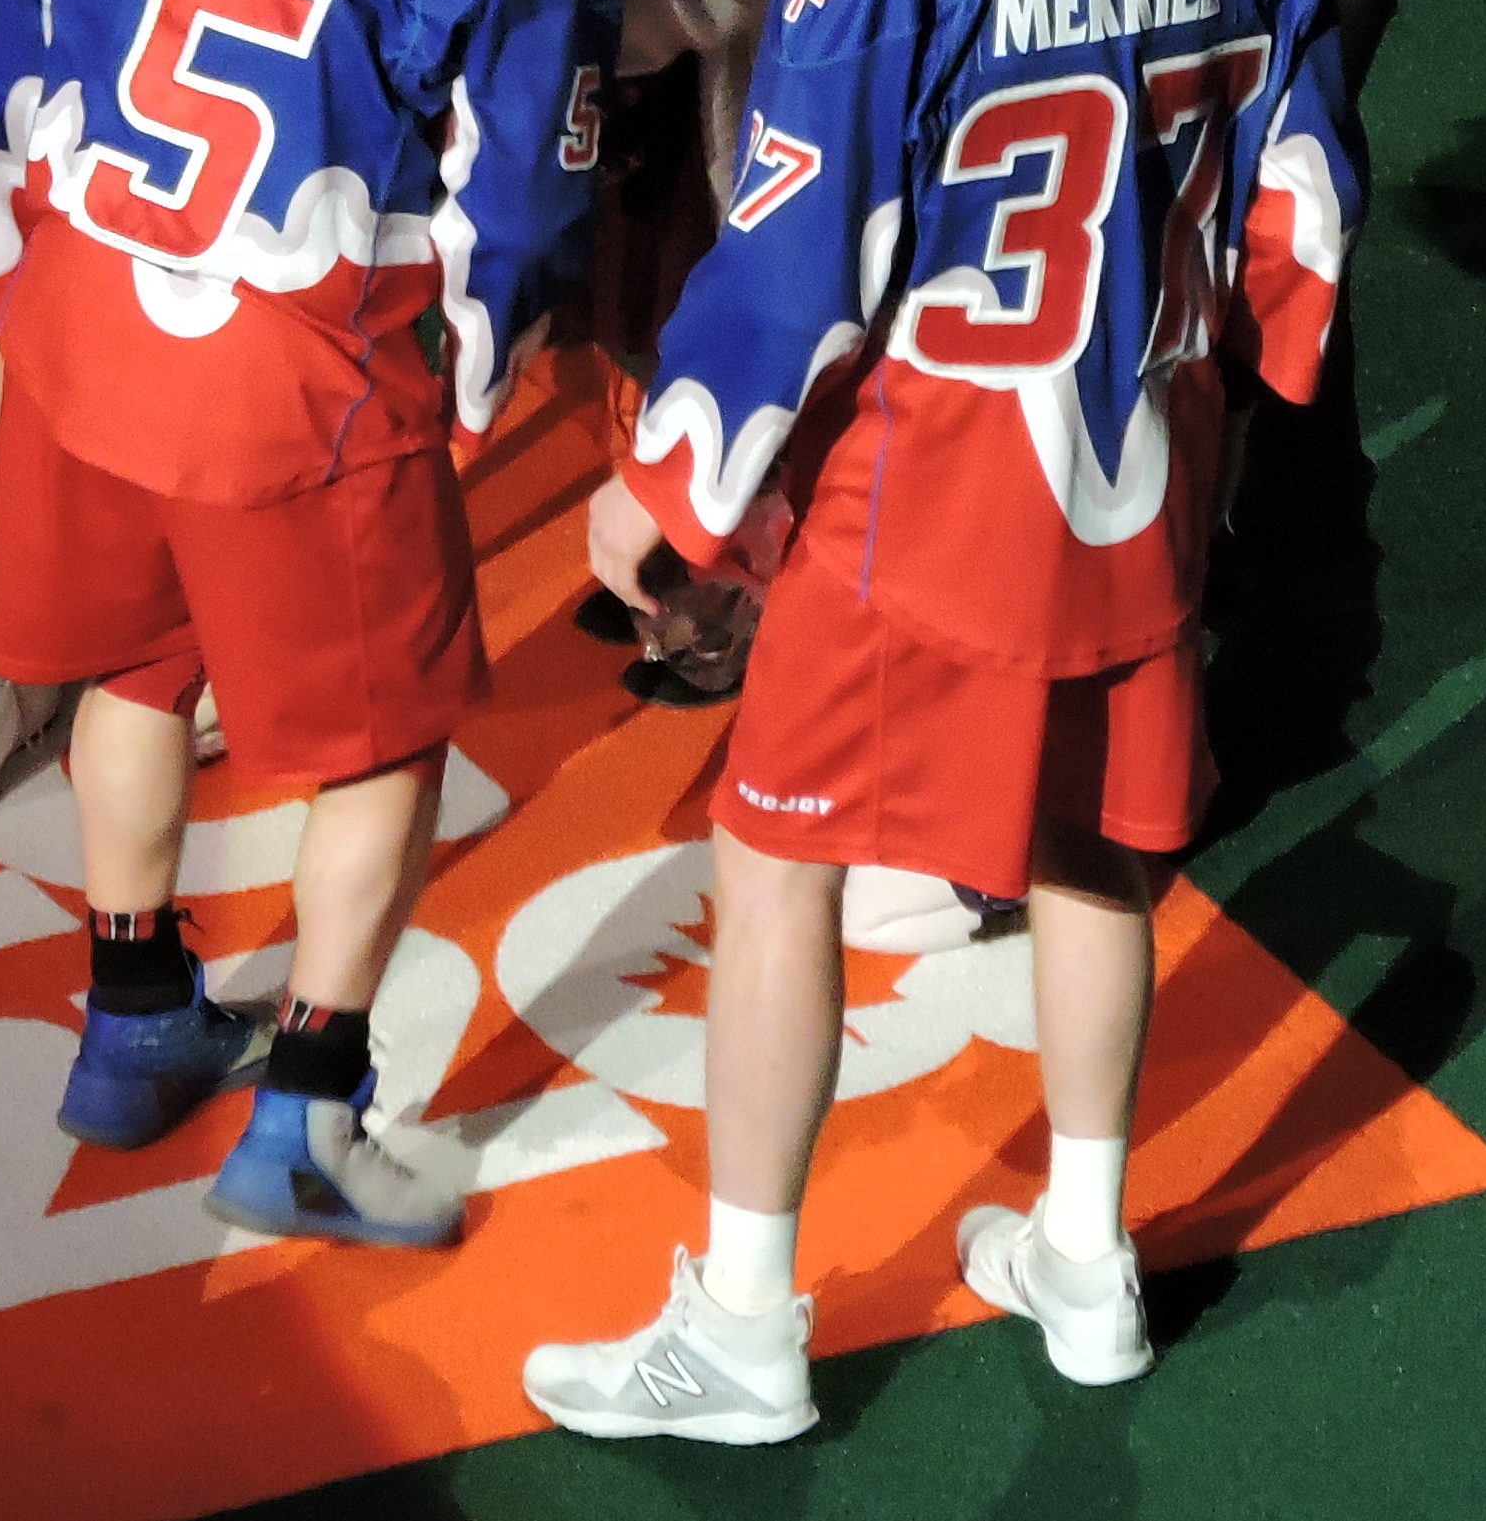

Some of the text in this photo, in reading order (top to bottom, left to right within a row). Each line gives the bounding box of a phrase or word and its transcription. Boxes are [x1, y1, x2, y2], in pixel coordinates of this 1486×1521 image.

[558, 66, 603, 171] 5
[729, 109, 822, 233] 7
[898, 35, 1273, 380] 37
[737, 782, 834, 815] PROJOY
